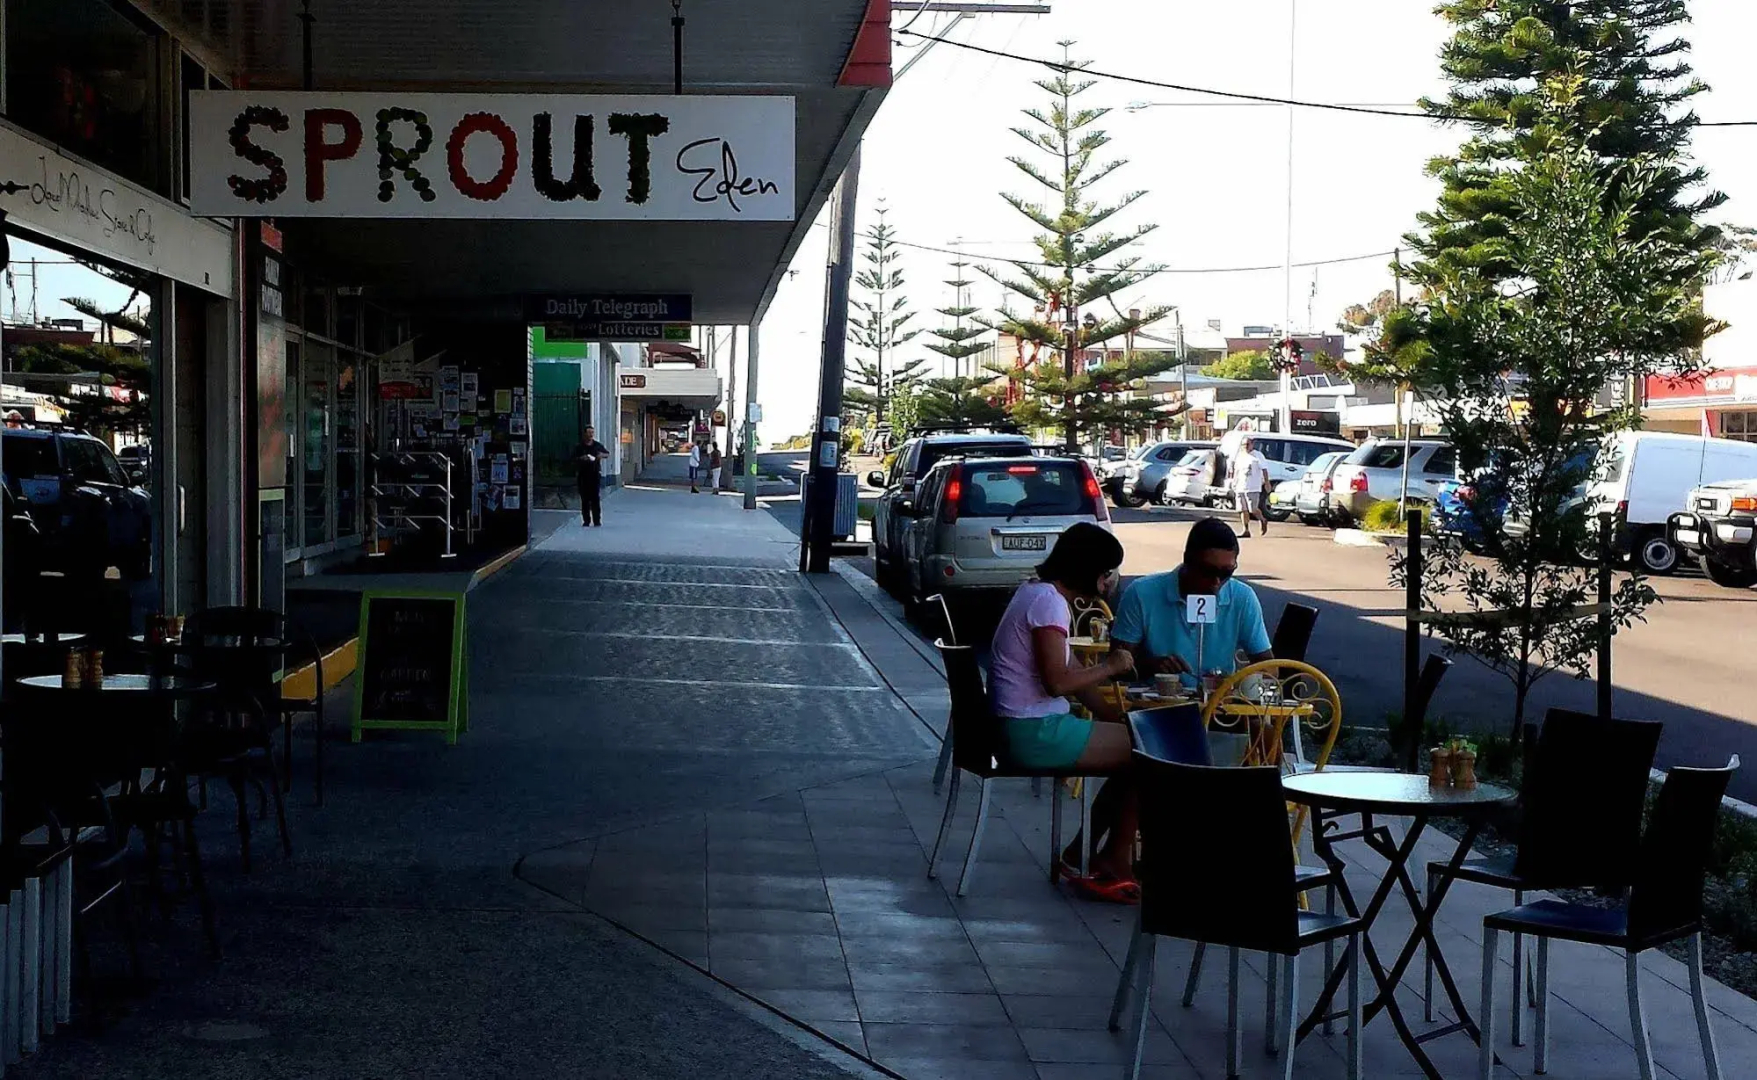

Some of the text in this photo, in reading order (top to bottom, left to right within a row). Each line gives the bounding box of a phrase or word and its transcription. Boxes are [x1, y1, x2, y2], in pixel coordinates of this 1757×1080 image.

[227, 105, 671, 205] SPROUT
[676, 137, 779, 213] Eden
[546, 298, 669, 319] Daily Telegraph
[598, 323, 660, 336] Lotteries
[1296, 417, 1317, 428] zero
[1196, 596, 1207, 616] 2
